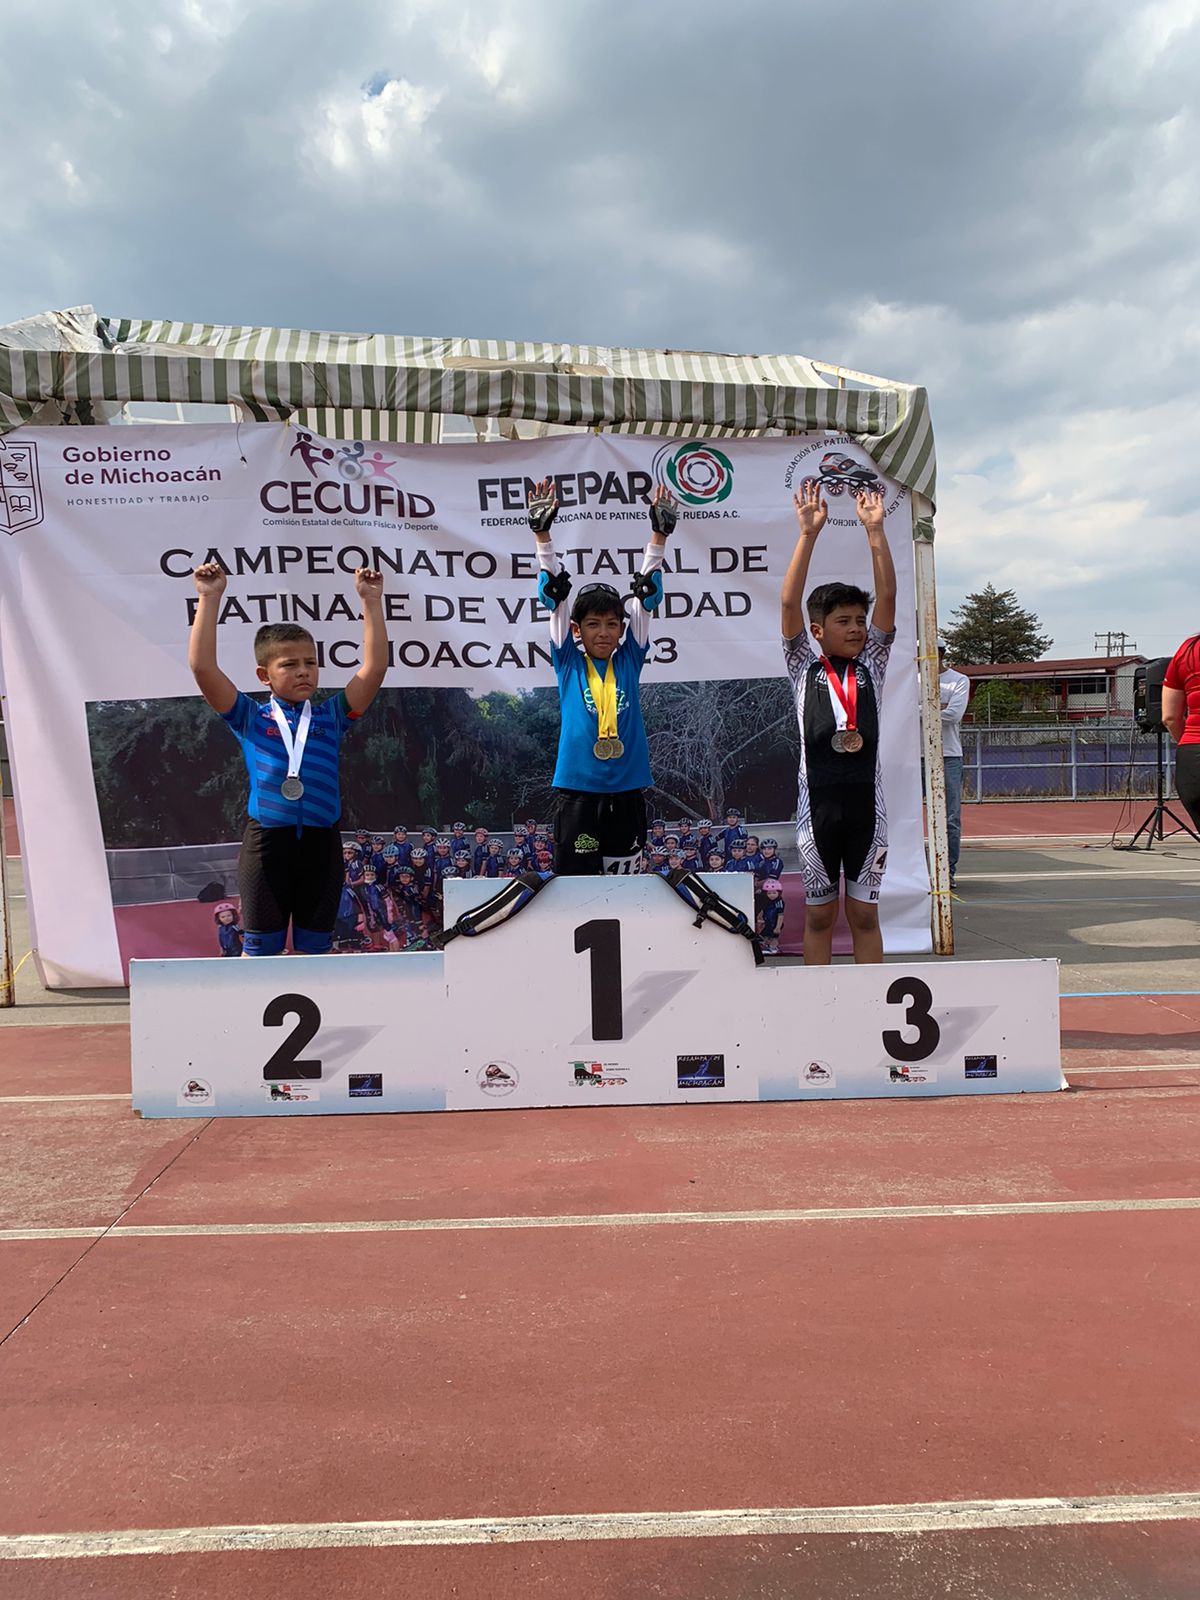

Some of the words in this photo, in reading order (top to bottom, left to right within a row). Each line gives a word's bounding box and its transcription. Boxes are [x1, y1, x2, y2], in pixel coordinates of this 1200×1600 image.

[63, 446, 171, 463] Gobierno
[810, 441, 823, 451] DE
[65, 469, 94, 485] de
[101, 466, 222, 484] Michoacán
[67, 496, 143, 506] HONESTIDAD
[160, 494, 210, 503] TRABAJO
[260, 480, 436, 519] CECUFID
[262, 518, 300, 526] Comisión
[302, 518, 329, 526] Estatal
[330, 518, 342, 526] de
[343, 518, 372, 527] Cultura
[398, 523, 403, 531] y
[404, 522, 439, 531] Deporte
[481, 517, 529, 527] FEDERACI
[553, 511, 593, 524] EXICANA
[595, 511, 607, 520] DE
[609, 511, 648, 520] PATINES
[683, 510, 721, 519] RUEDAS
[723, 510, 741, 519] A.C.
[160, 545, 497, 579] CAMPEONATO
[709, 545, 768, 574] DE
[185, 593, 412, 627] ATINAE
[424, 594, 487, 625] DE
[496, 591, 752, 624] VEDAD
[315, 640, 554, 669] ICOACAN
[574, 919, 623, 1042] 1
[882, 976, 941, 1062] 3
[263, 993, 322, 1081] 2
